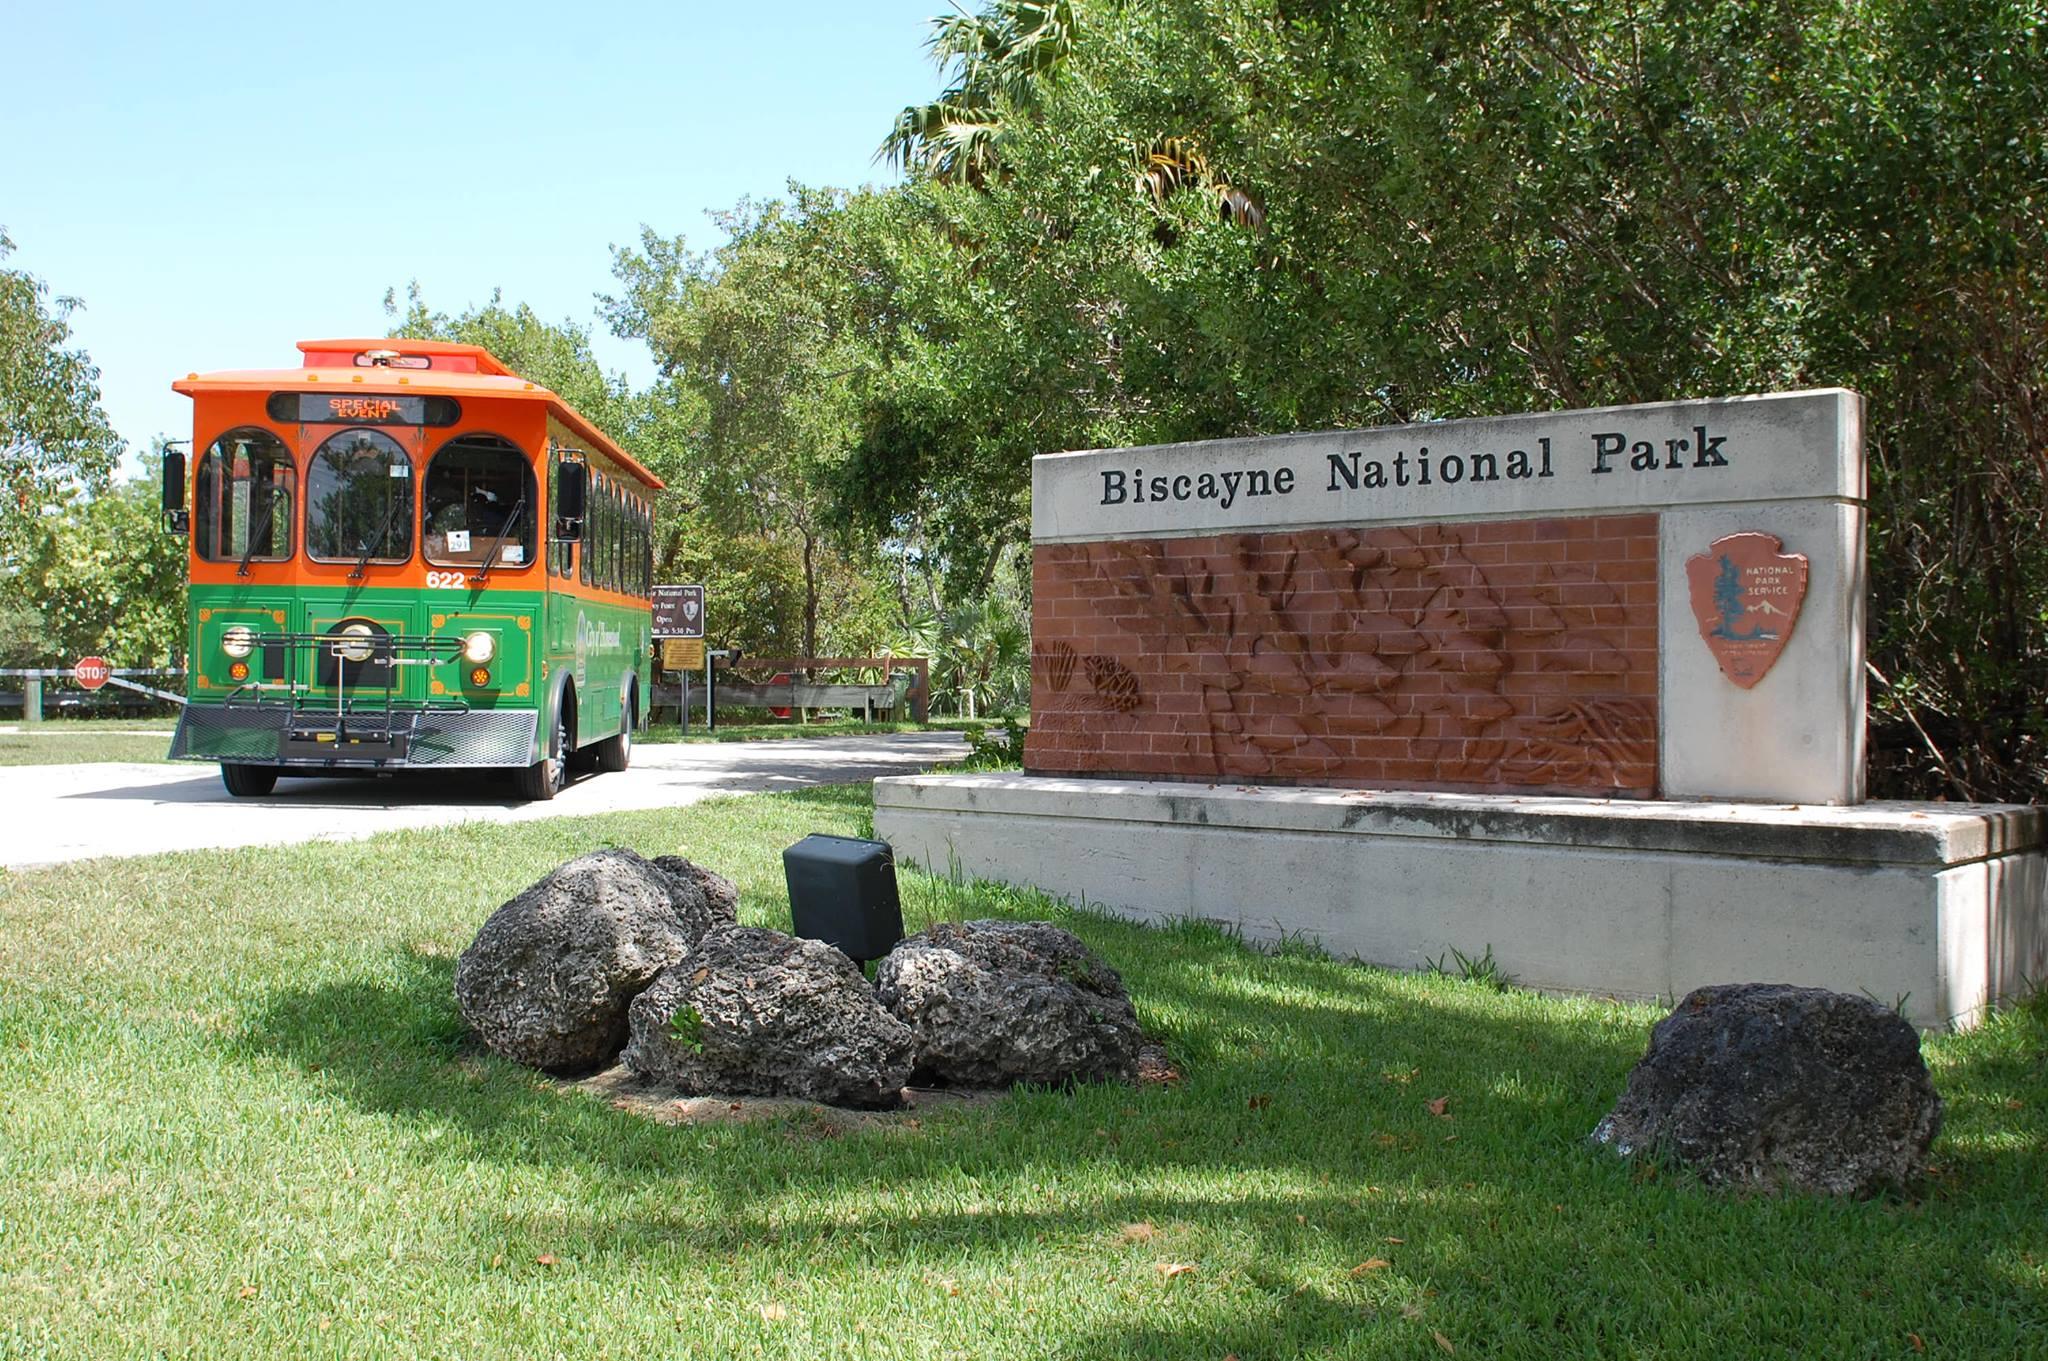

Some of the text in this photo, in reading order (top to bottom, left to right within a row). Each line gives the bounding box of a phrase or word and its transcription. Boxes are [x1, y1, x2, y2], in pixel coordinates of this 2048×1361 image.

[329, 399, 401, 411] SPECIAL
[338, 408, 390, 418] EVENT
[1100, 425, 1729, 509] Biscayne National Park
[1746, 566, 1794, 575] NATIONAL
[426, 571, 464, 589] 622
[1755, 577, 1780, 585] PARK
[1748, 586, 1788, 596] SERVICE
[656, 615, 672, 624] Open
[79, 667, 107, 679] STOP
